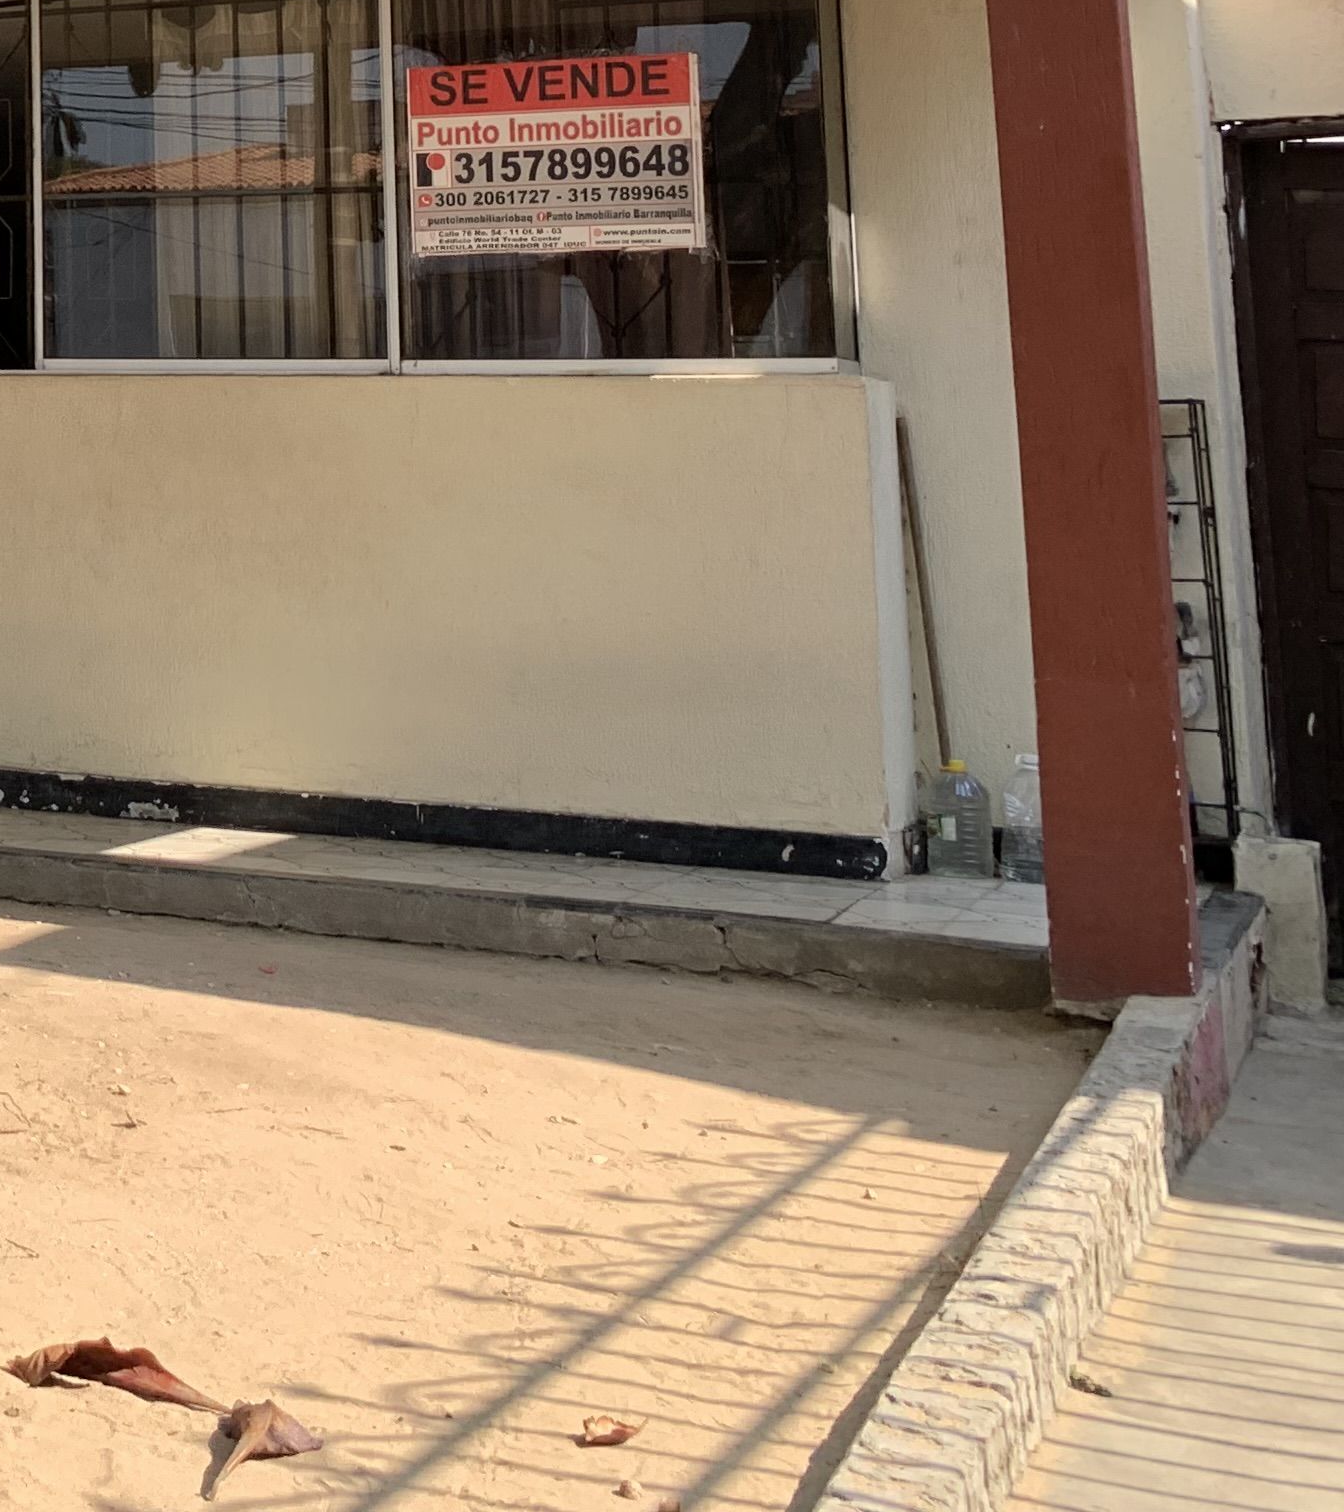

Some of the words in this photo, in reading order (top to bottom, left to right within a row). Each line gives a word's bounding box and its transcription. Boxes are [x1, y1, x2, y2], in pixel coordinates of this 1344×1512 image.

[429, 69, 488, 106] SE
[502, 59, 670, 102] VENDE
[417, 120, 499, 147] Punto
[509, 110, 682, 143] Inmobiliario
[454, 144, 689, 184] 3157899648
[434, 192, 467, 207] 300
[473, 189, 551, 206] 2061727
[568, 187, 601, 202] 315
[608, 185, 689, 201] 7899645
[546, 211, 573, 222] Punto
[633, 208, 692, 221] Barranquilla
